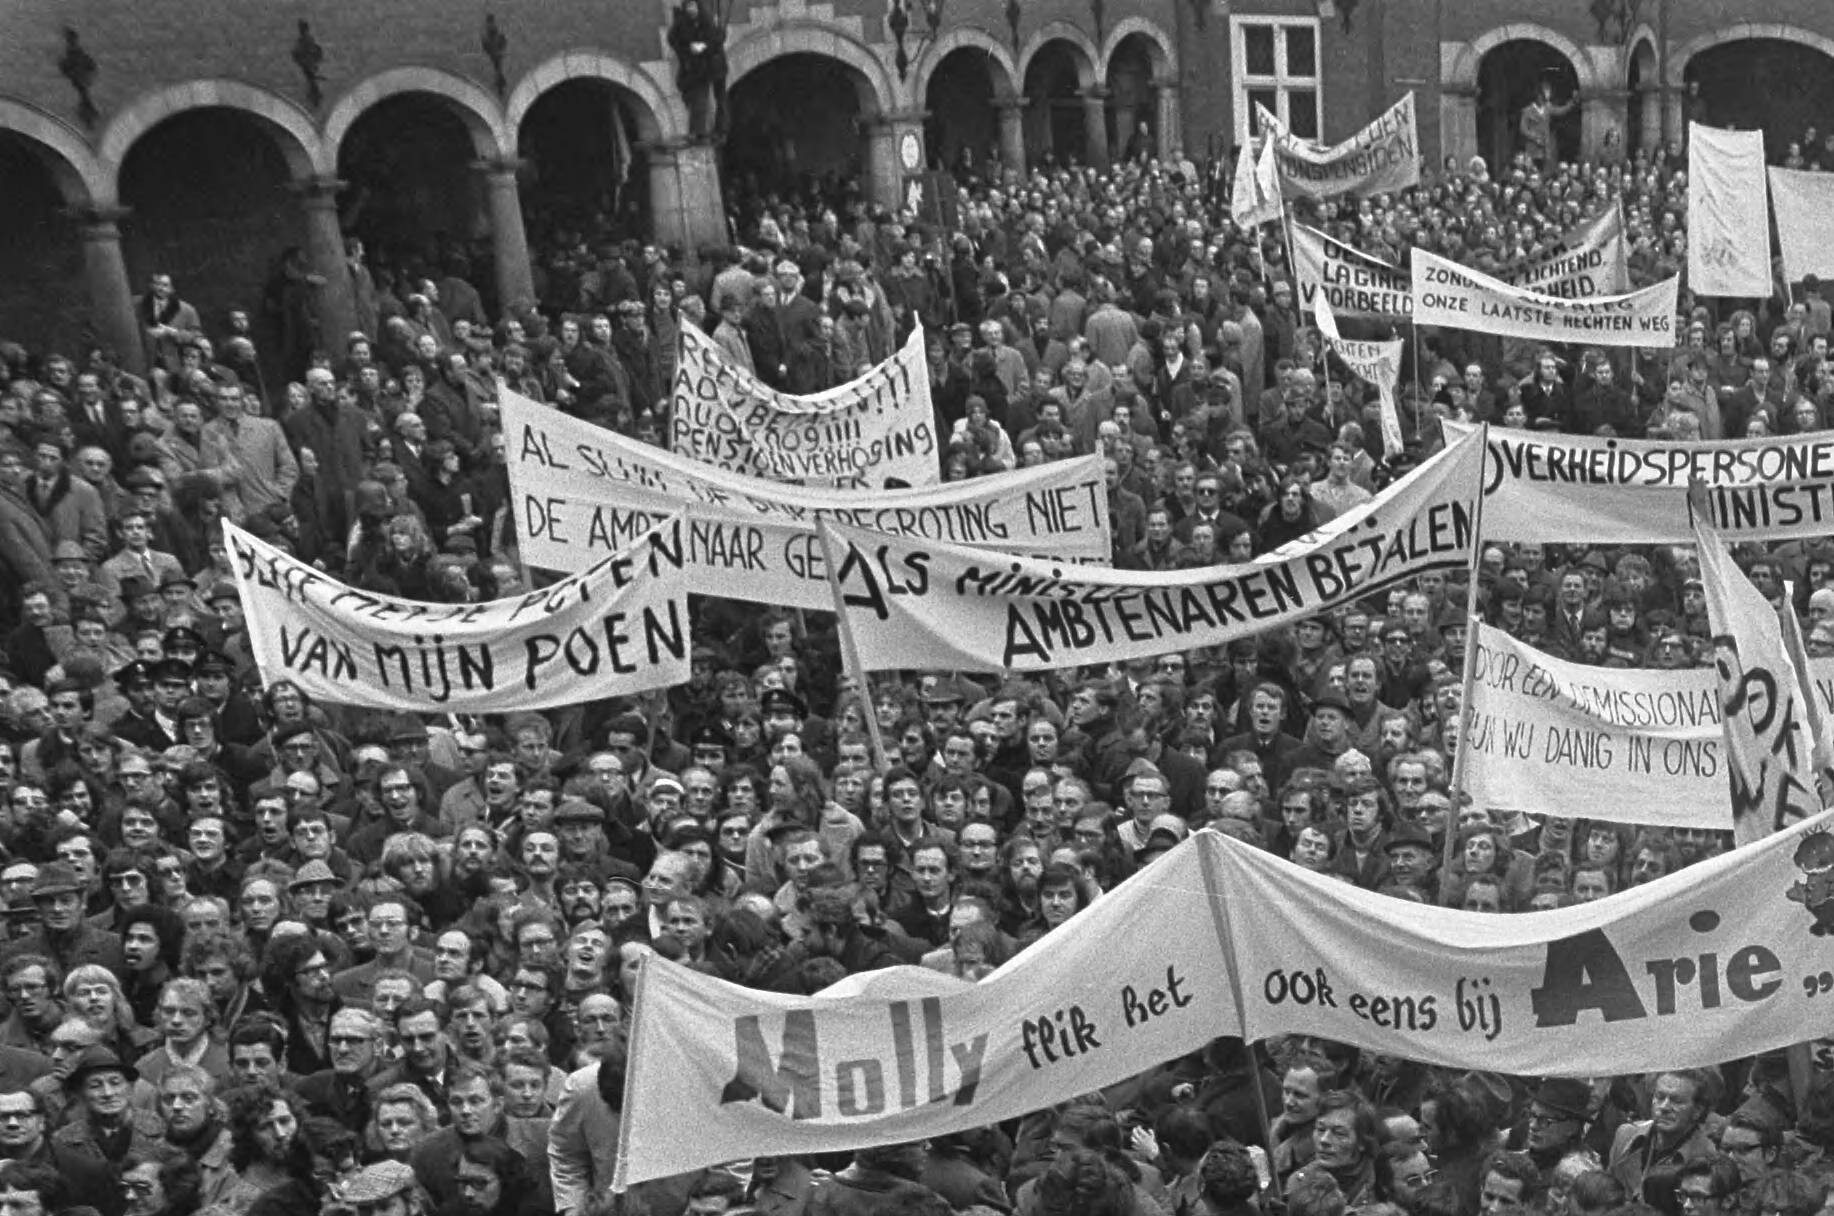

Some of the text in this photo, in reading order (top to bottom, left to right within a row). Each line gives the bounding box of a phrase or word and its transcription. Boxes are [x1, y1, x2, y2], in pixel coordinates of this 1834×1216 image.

[1301, 282, 1413, 315] VORBEELD
[1423, 293, 1469, 312] ONZE
[1482, 301, 1553, 325] LAATSTE
[1563, 314, 1633, 331] RECHTEN
[1639, 314, 1670, 332] WEG
[521, 423, 570, 470] AL
[1025, 480, 1101, 536] NIET
[525, 494, 829, 580] DE AMBTNAAR GE
[838, 540, 931, 621] ALS
[1003, 561, 1304, 668] AMBTENAREN
[1306, 499, 1475, 601] BETALEN
[280, 624, 358, 681] VAN
[525, 599, 686, 690] POEN
[1474, 644, 1519, 692] DOOR
[1522, 663, 1561, 699] EEN
[1503, 717, 1535, 760] WIJ
[1544, 725, 1613, 770] DANIG
[1628, 734, 1652, 774] IN
[1663, 738, 1718, 777] ONS
[721, 962, 1194, 1121] Molly flik het
[1348, 992, 1438, 1033] eens
[1457, 978, 1504, 1041] bij
